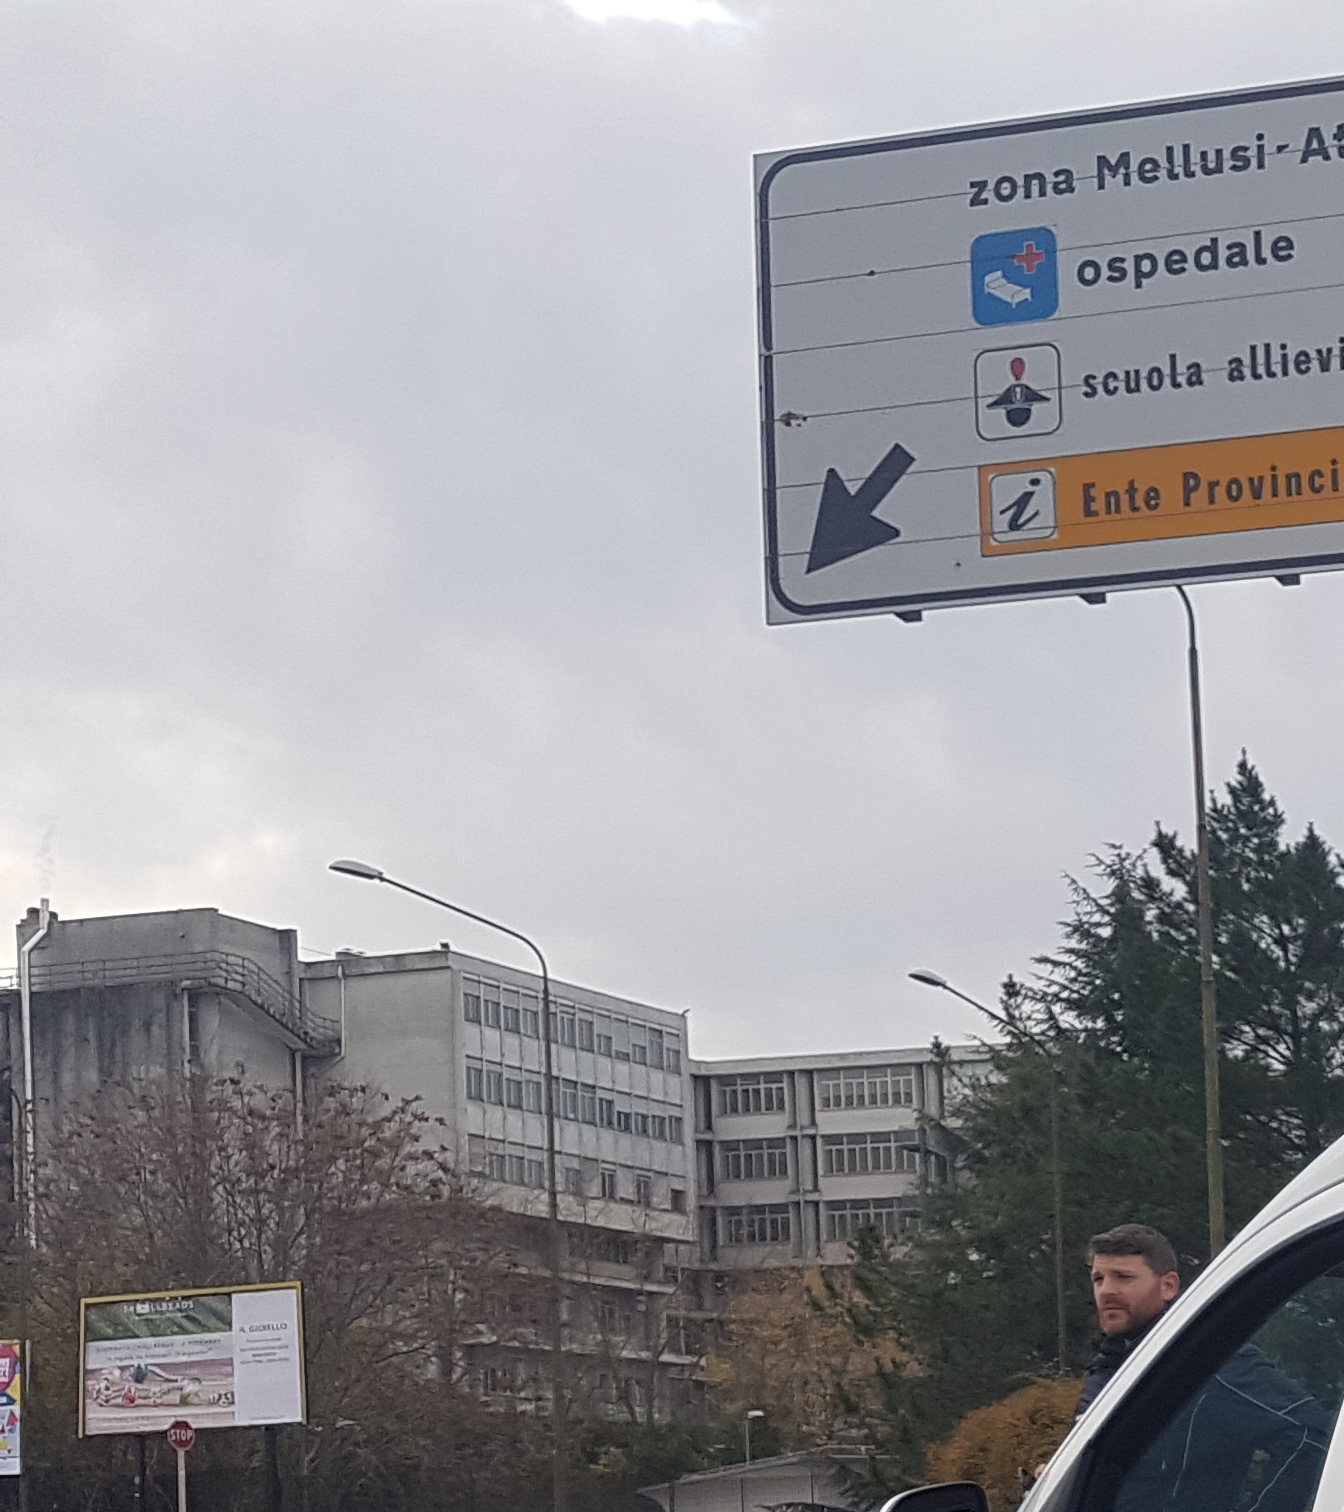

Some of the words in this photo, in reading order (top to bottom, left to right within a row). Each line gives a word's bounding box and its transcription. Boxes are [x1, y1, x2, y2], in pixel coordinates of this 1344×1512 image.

[967, 165, 1076, 208] zona
[1075, 228, 1297, 290] ospedale
[1081, 351, 1204, 400] scuola
[1081, 480, 1162, 519] Ente
[169, 1428, 194, 1441] STOP
